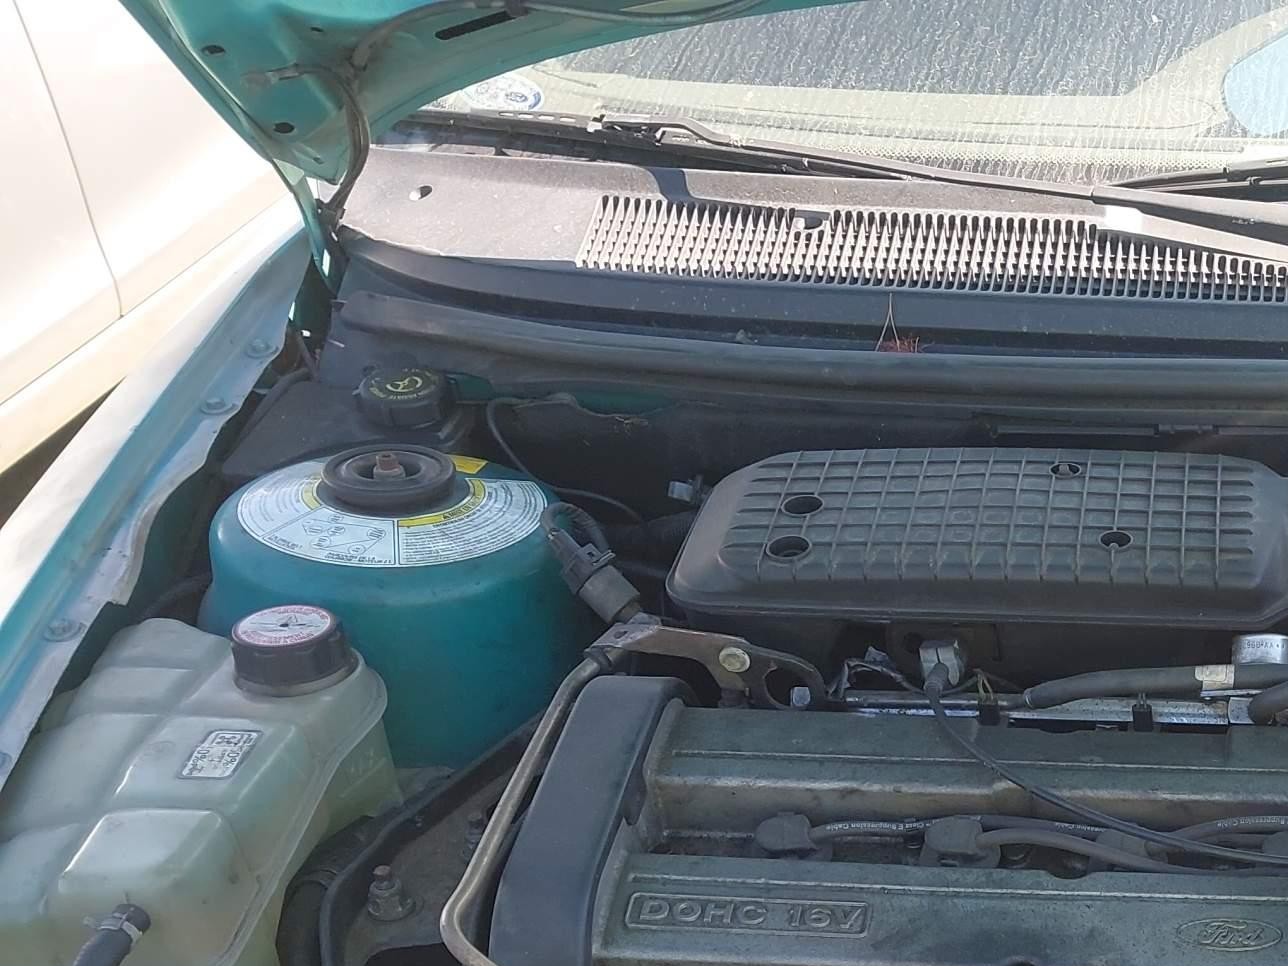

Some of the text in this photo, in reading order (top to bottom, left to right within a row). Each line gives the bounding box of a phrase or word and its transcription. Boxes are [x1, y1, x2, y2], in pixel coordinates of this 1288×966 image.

[640, 901, 862, 929] DOHC 16V
[1200, 921, 1264, 945] Ford
